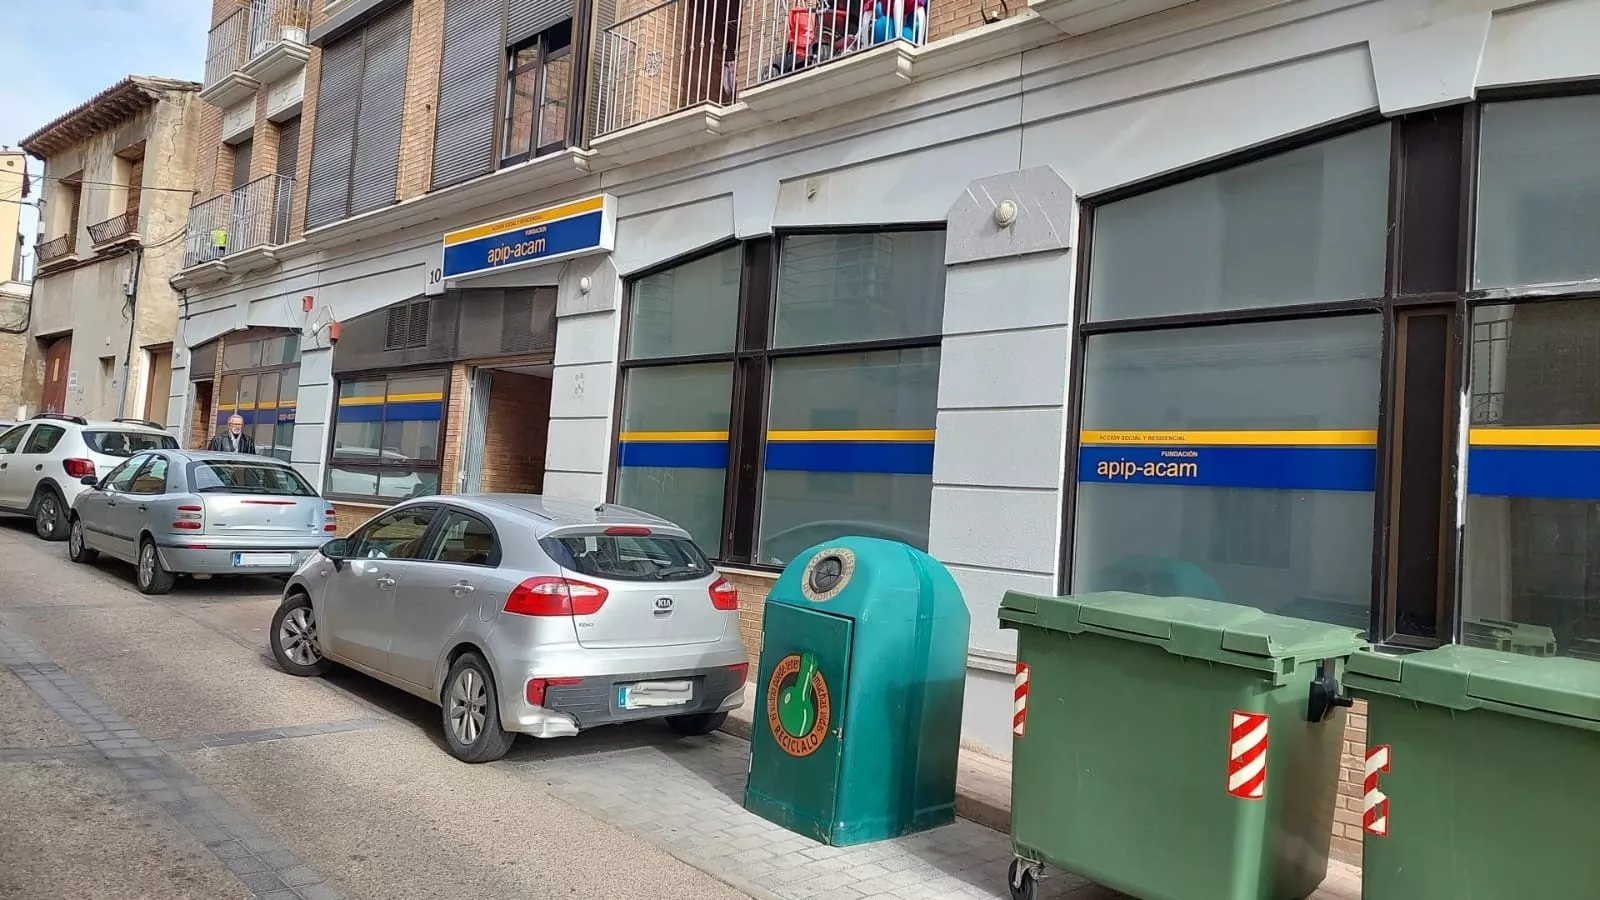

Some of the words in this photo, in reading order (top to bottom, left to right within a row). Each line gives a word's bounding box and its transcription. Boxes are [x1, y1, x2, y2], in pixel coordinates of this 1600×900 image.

[487, 237, 546, 265] apip-acam
[429, 268, 441, 285] 10
[1160, 450, 1198, 458] FUNDACIÓN
[1097, 457, 1198, 480] apip-acam
[657, 599, 672, 608] KIA
[812, 675, 827, 709] muchas
[774, 726, 818, 753] RECICLALO
